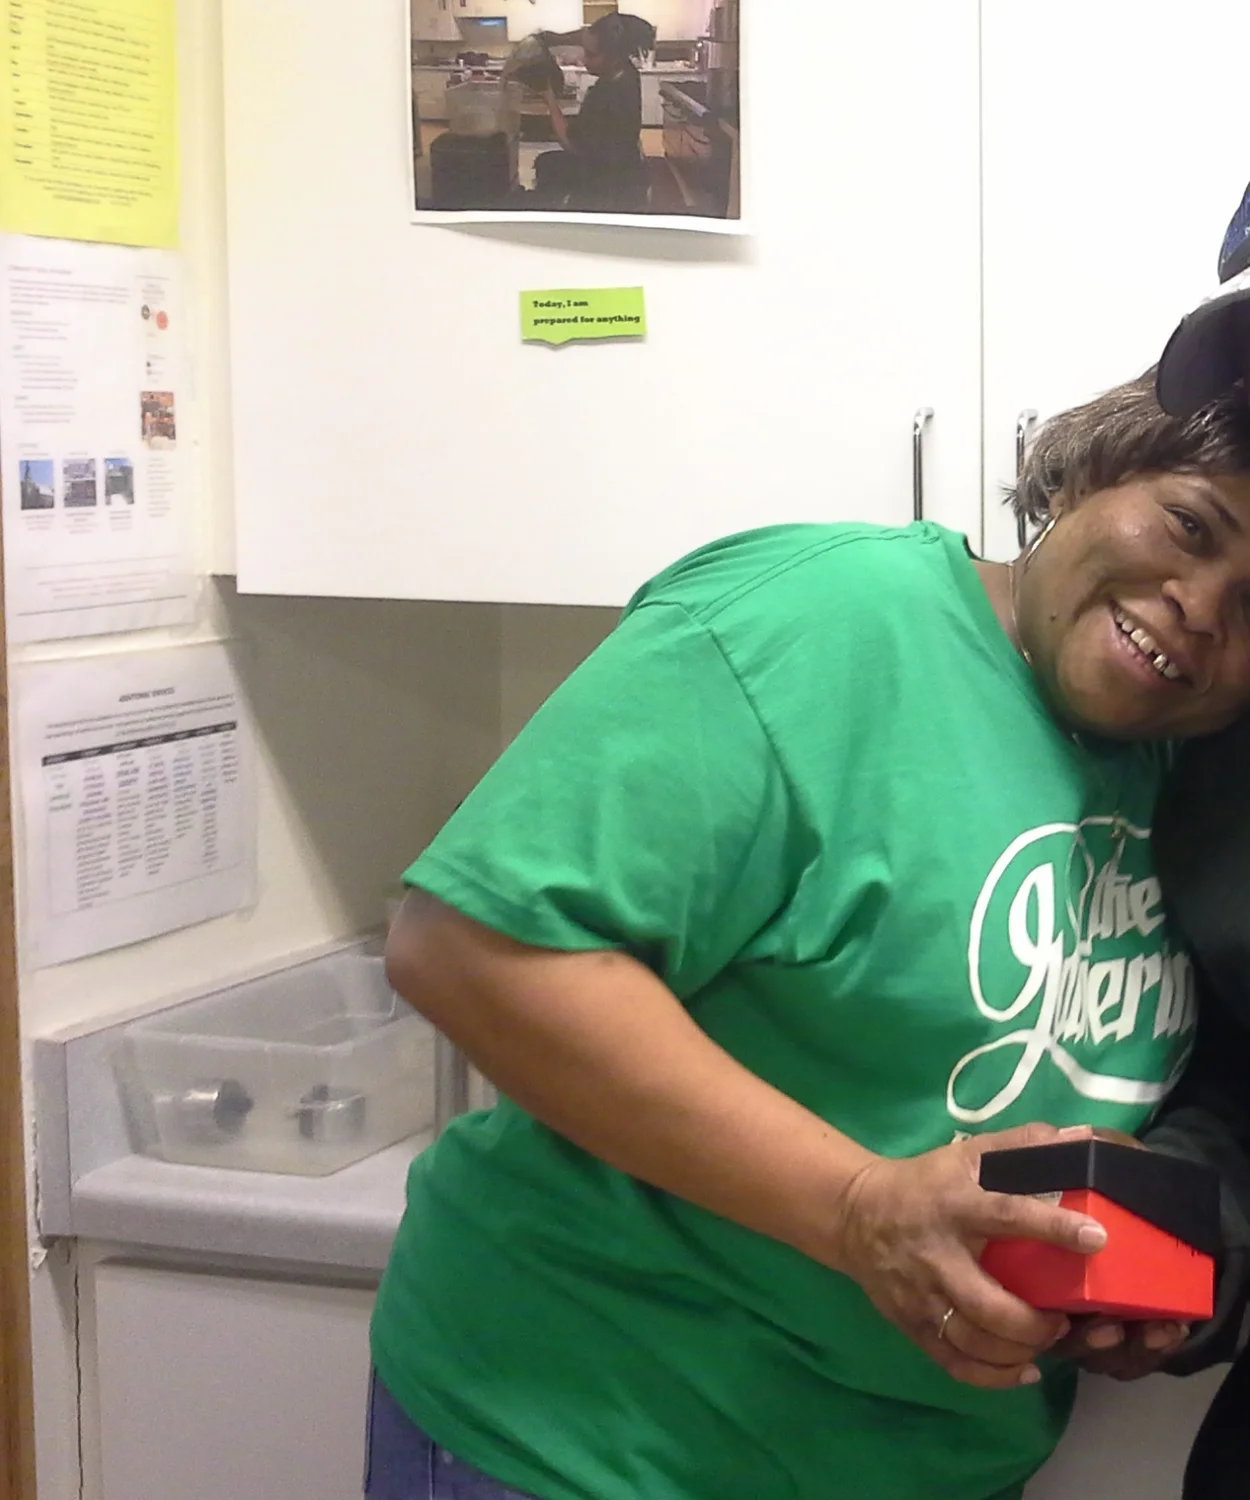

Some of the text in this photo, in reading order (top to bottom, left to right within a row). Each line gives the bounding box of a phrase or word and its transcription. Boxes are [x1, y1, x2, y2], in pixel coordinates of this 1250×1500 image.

[532, 299, 566, 309] Today,
[534, 314, 640, 326] prepared for anything
